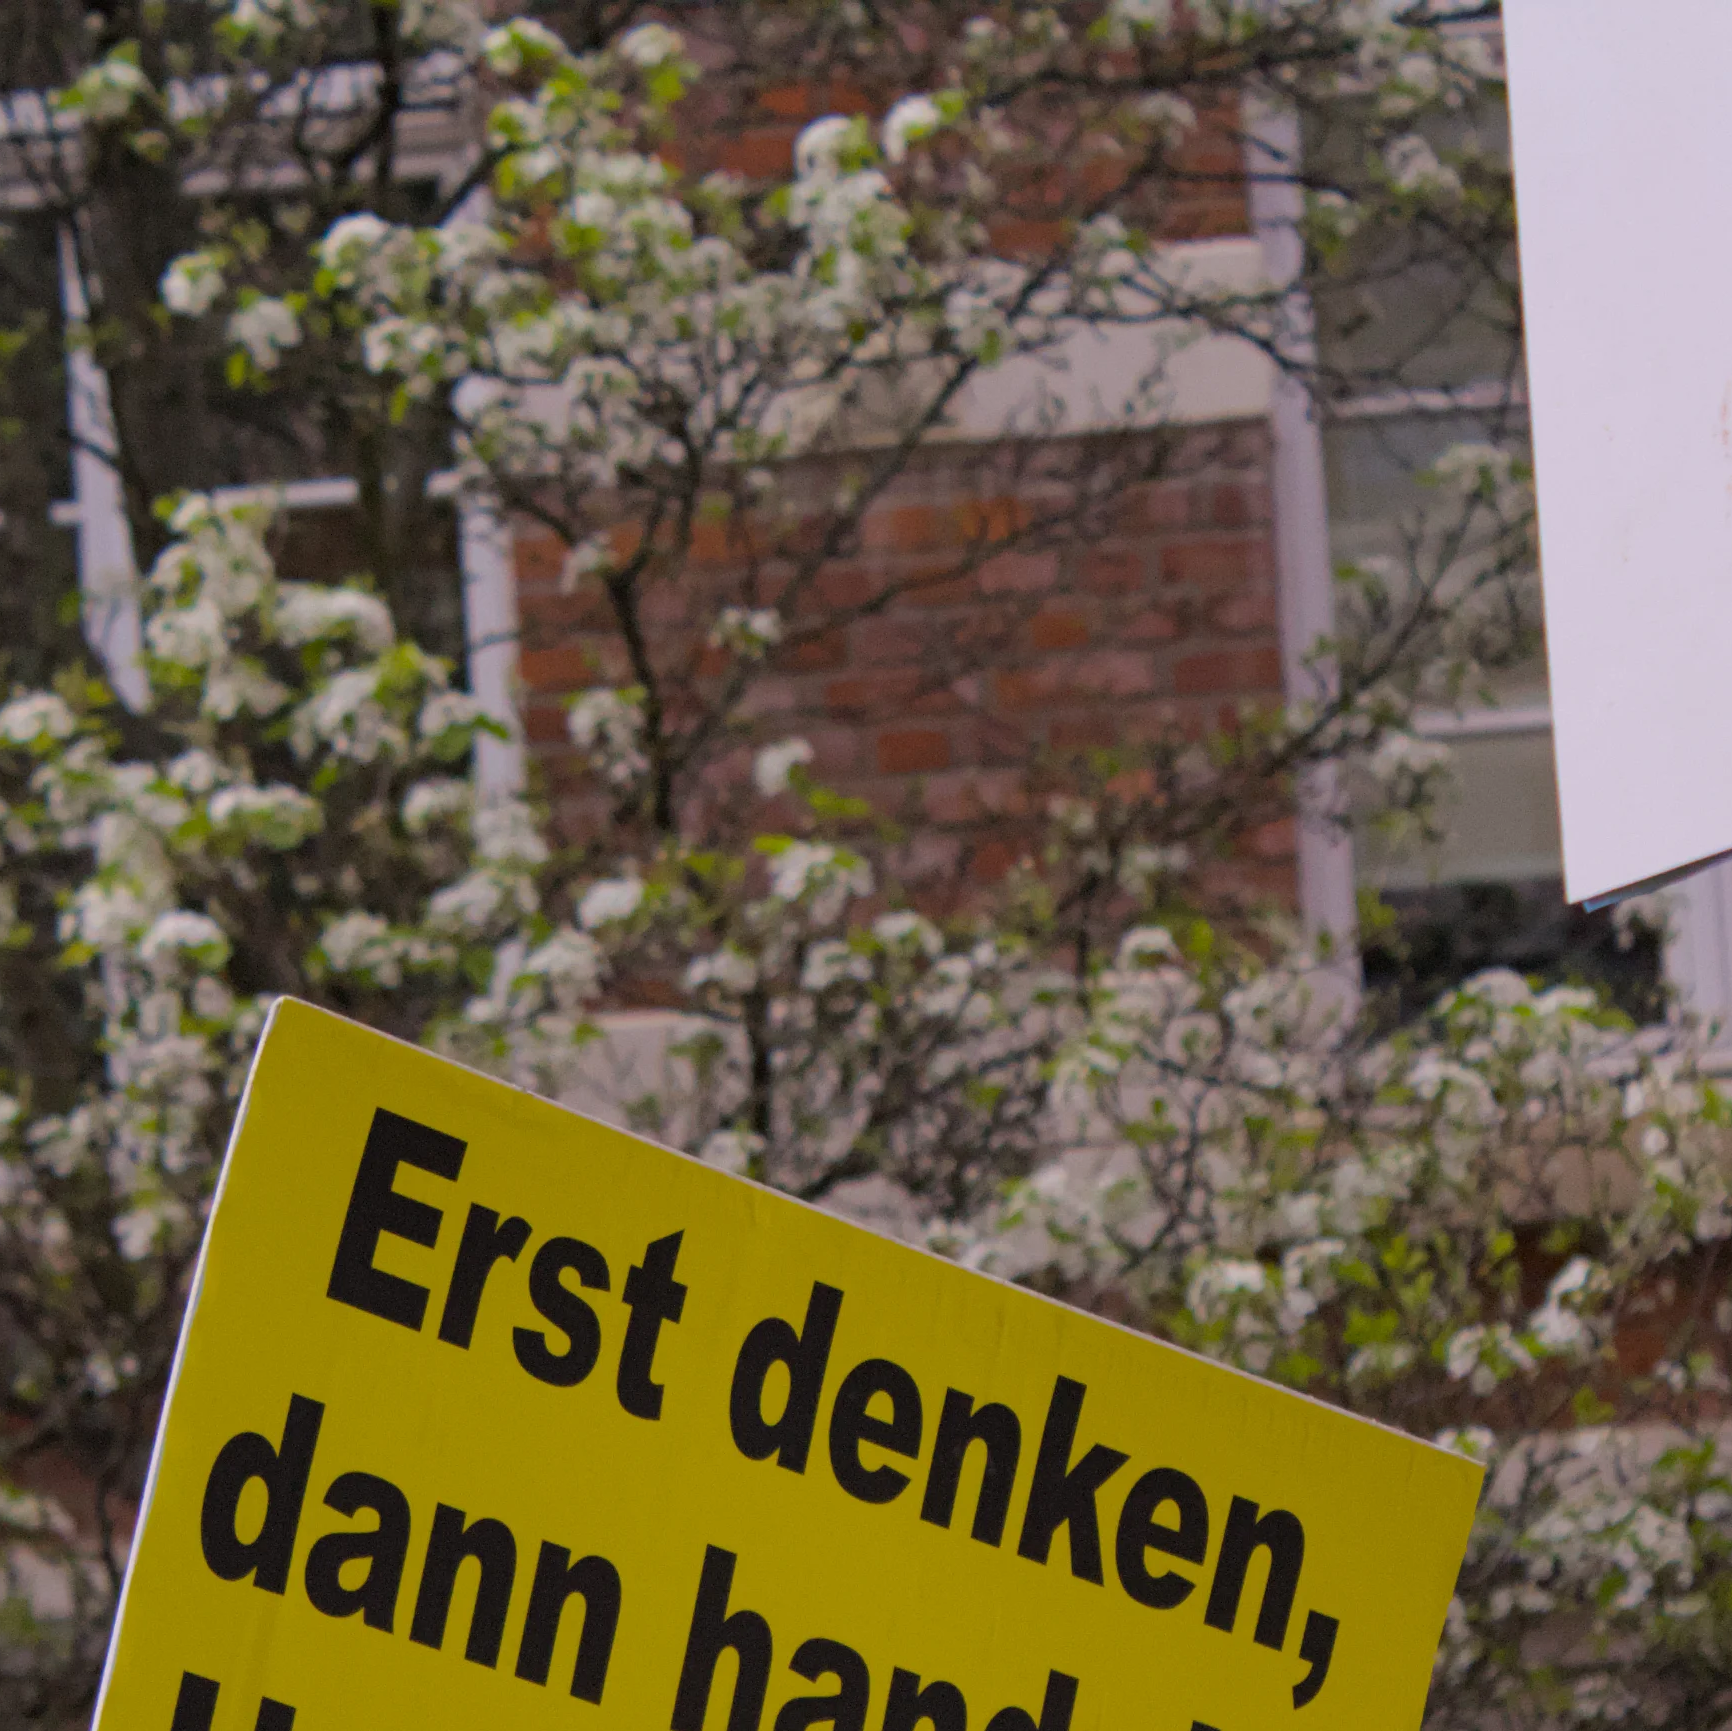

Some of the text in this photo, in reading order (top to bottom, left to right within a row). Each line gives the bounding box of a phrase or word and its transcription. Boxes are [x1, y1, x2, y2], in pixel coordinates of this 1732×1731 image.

[201, 1393, 621, 1705] dann
[327, 1107, 1339, 1709] Erst denken,
